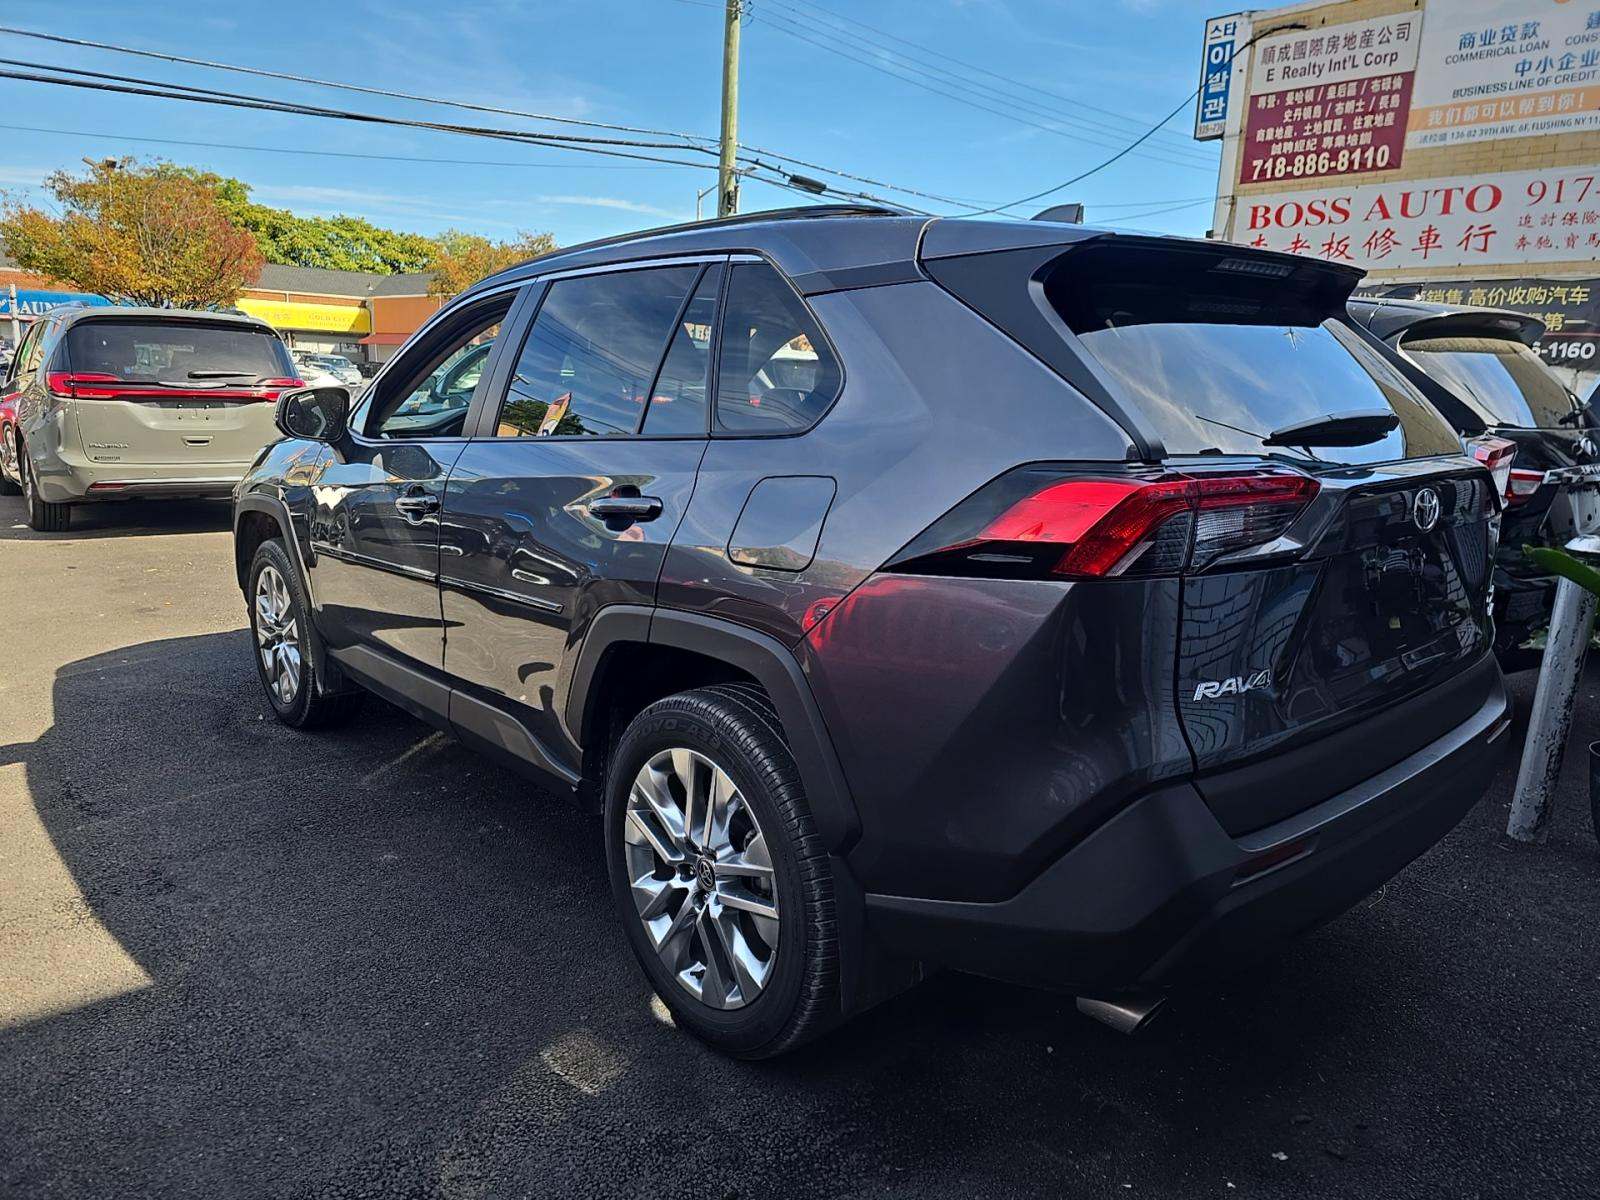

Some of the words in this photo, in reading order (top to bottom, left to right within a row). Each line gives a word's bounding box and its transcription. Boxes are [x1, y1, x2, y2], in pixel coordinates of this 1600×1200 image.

[1210, 22, 1237, 40] 스타
[1458, 20, 1541, 51] 商业贷款
[1565, 32, 1600, 46] CONS
[1266, 69, 1275, 82] E
[1282, 61, 1325, 79] Realty
[1328, 55, 1359, 73] Int'L
[1364, 51, 1398, 67] Corp
[1445, 45, 1519, 65] COMMERICAL
[1520, 40, 1550, 53] LOAN
[1204, 44, 1232, 119] 이발관
[1452, 81, 1507, 99] BUSINESS
[1509, 76, 1534, 91] LINE
[1537, 75, 1552, 87] OF
[1554, 69, 1596, 85] CREDIT
[1532, 119, 1572, 132] FLUSHING
[1574, 116, 1587, 125] NY
[1252, 145, 1390, 180] 718-886-8110
[1247, 197, 1352, 230] BOSS
[1363, 183, 1503, 221] AUTO
[1467, 286, 1591, 306] 高价收购汽车
[1193, 669, 1270, 701] RAV4
